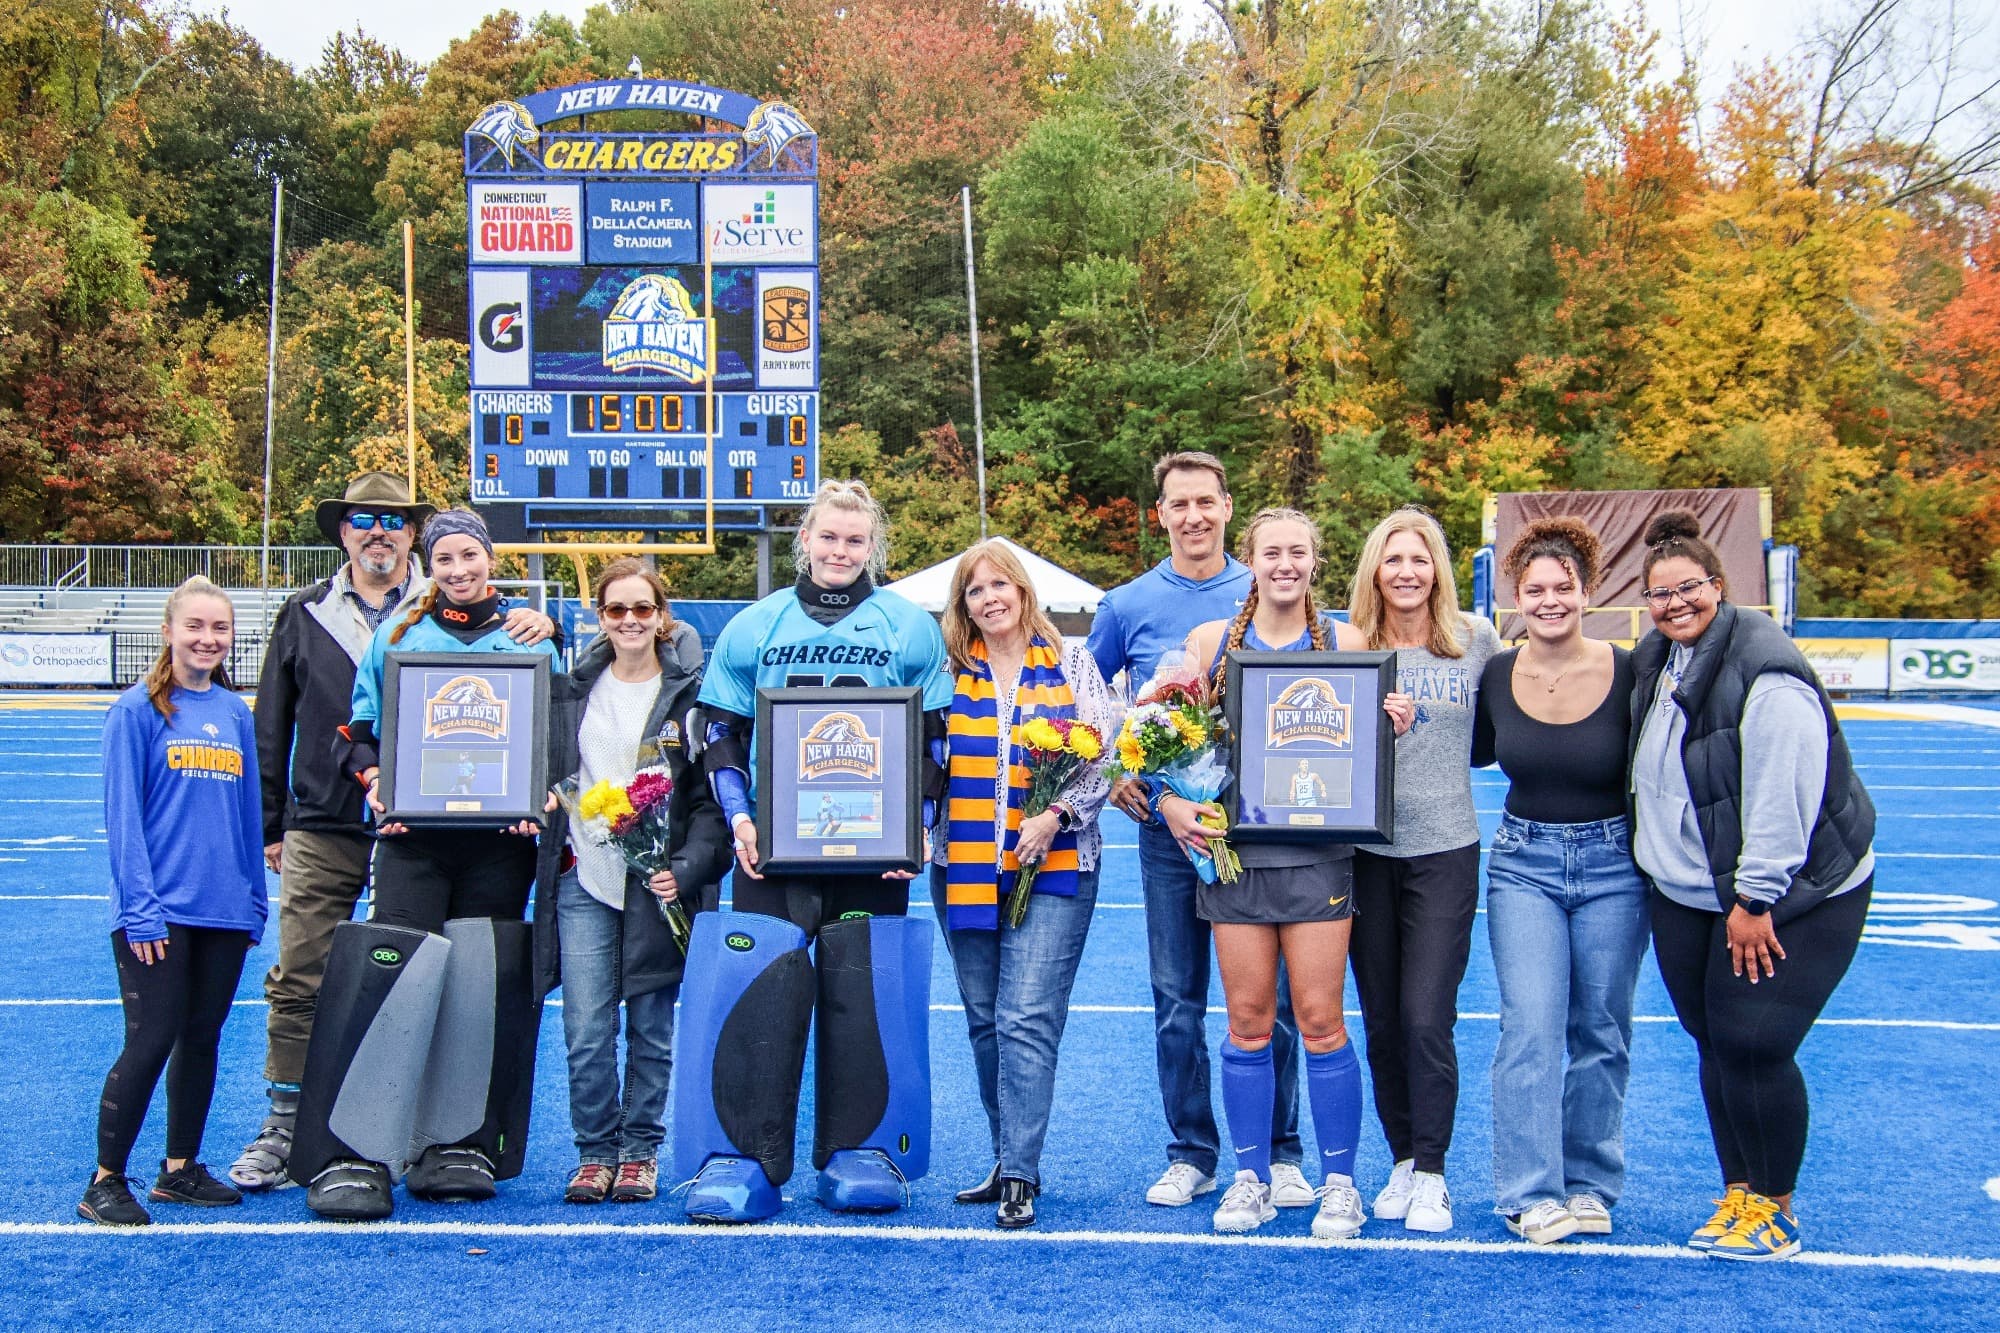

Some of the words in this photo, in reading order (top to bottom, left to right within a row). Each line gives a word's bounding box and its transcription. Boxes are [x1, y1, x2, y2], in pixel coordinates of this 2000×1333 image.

[555, 85, 623, 114] NEW
[626, 84, 723, 113] HAVEN
[543, 141, 738, 170] CHARGERS
[483, 192, 547, 204] CONNECTICUT
[610, 199, 656, 213] RALPH
[660, 199, 674, 212] F.
[480, 206, 552, 221] NATIONAL
[480, 222, 573, 252] GUARD
[613, 234, 672, 249] STADIUM
[713, 219, 803, 246] iServe
[607, 323, 639, 354] NEW
[642, 323, 705, 362] HAVEN
[616, 349, 692, 375] CHARGERS
[763, 360, 788, 370] ARMY
[789, 360, 812, 370] ROTC
[478, 394, 552, 414] CHARGERS
[587, 395, 683, 431] 15:00
[747, 395, 810, 415] GUEST
[505, 415, 523, 445] 0
[789, 416, 807, 446] 0
[485, 453, 499, 477] 3
[525, 450, 569, 466] DOWN
[588, 450, 606, 466] TO
[610, 450, 630, 466] GO
[655, 450, 687, 466] BALL
[689, 450, 707, 466] ON
[728, 452, 757, 467] QTR
[791, 455, 805, 479] 3
[475, 479, 510, 496] T.O.L.
[780, 481, 815, 497] T.O.L.
[33, 656, 108, 667] Orthopaedics
[761, 645, 893, 668] CHARGERS
[1902, 649, 1975, 679] QBG
[1448, 667, 1468, 677] OF
[1403, 677, 1469, 708] HAVEN
[433, 704, 458, 723] NEW
[462, 704, 502, 723] HAVEN
[1275, 709, 1302, 729] NEW
[1305, 709, 1344, 729] HAVEN
[440, 719, 493, 732] CHARGERS
[1283, 725, 1337, 739] CHARGERS
[806, 743, 831, 763] NEW
[836, 743, 875, 763] HAVEN
[182, 769, 209, 778] FIELD
[814, 758, 867, 771] CHARGERS
